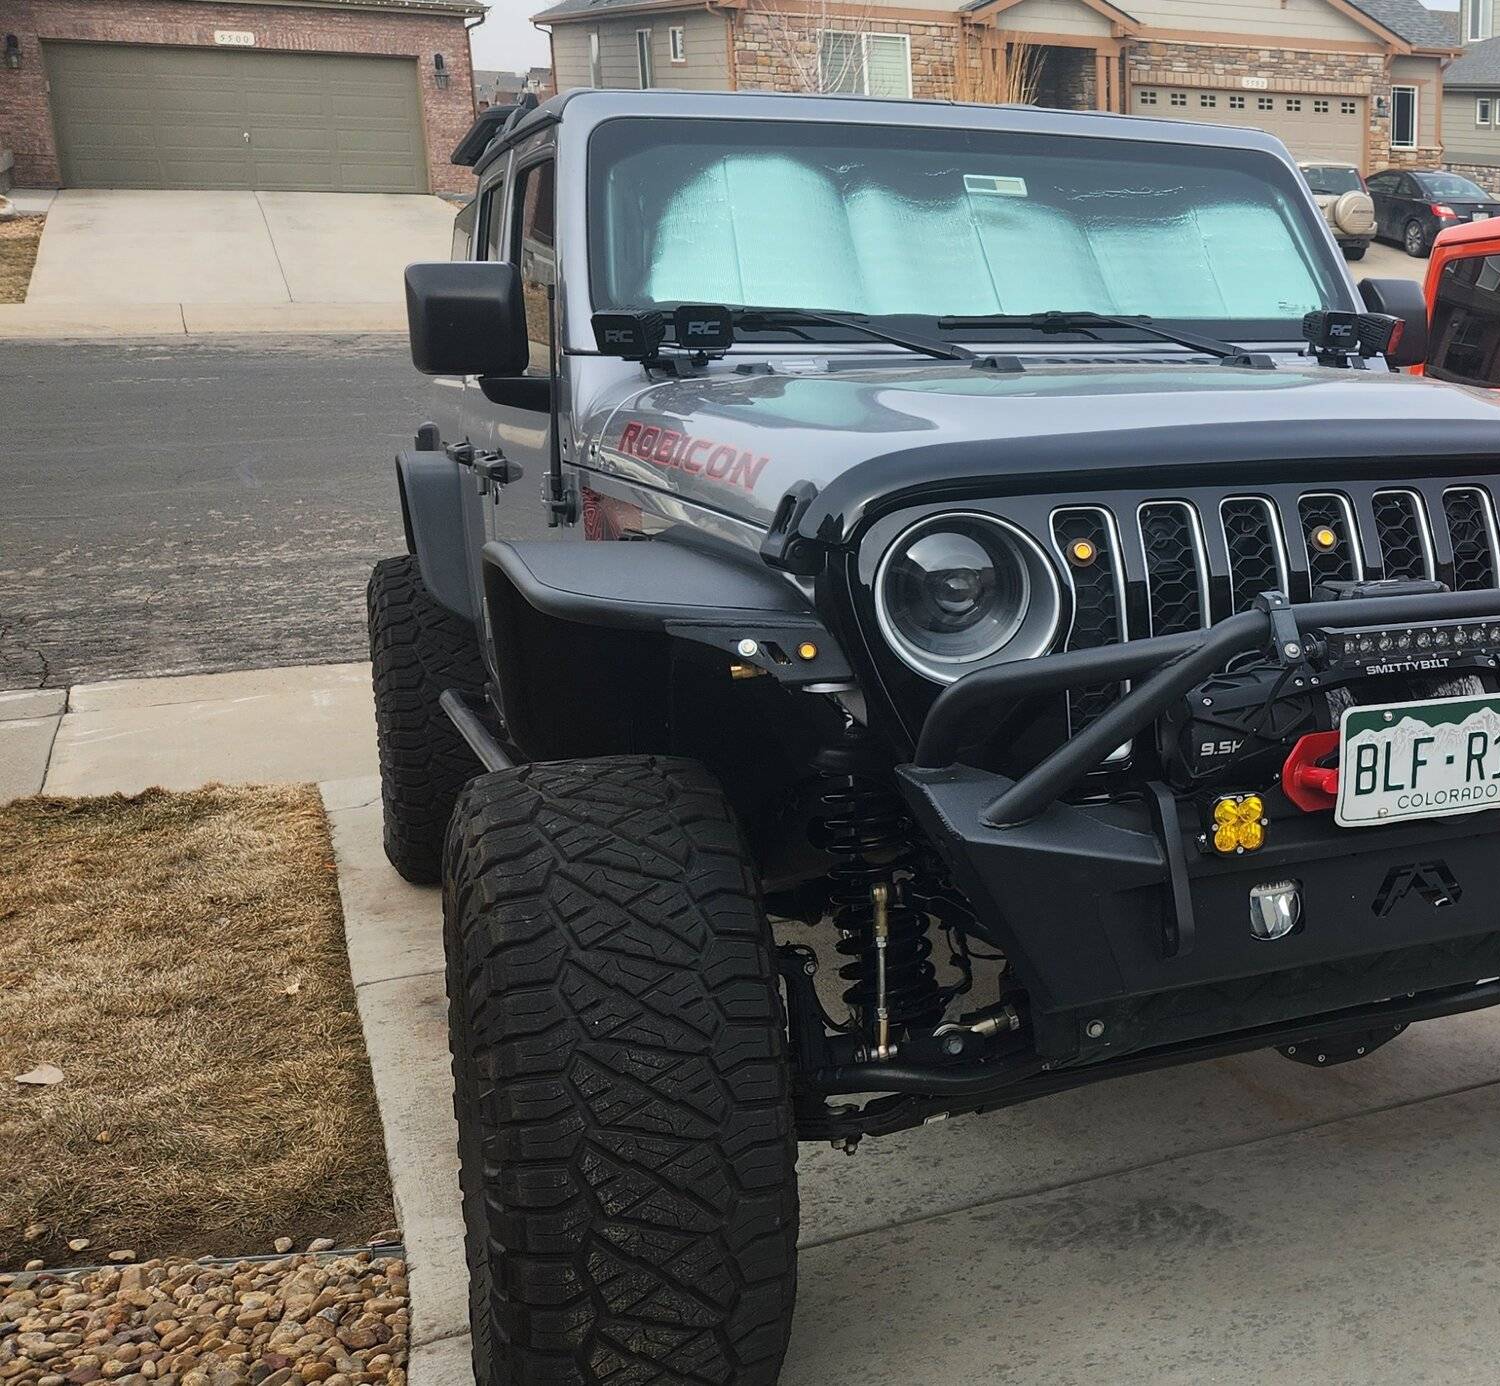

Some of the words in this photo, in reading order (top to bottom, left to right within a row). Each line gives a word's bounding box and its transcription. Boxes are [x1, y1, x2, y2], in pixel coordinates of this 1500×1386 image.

[689, 321, 721, 335] RC
[1330, 324, 1353, 337] RC
[605, 329, 634, 343] RC
[1366, 658, 1449, 675] SMITTYBILT
[1397, 784, 1498, 809] COLORADO
